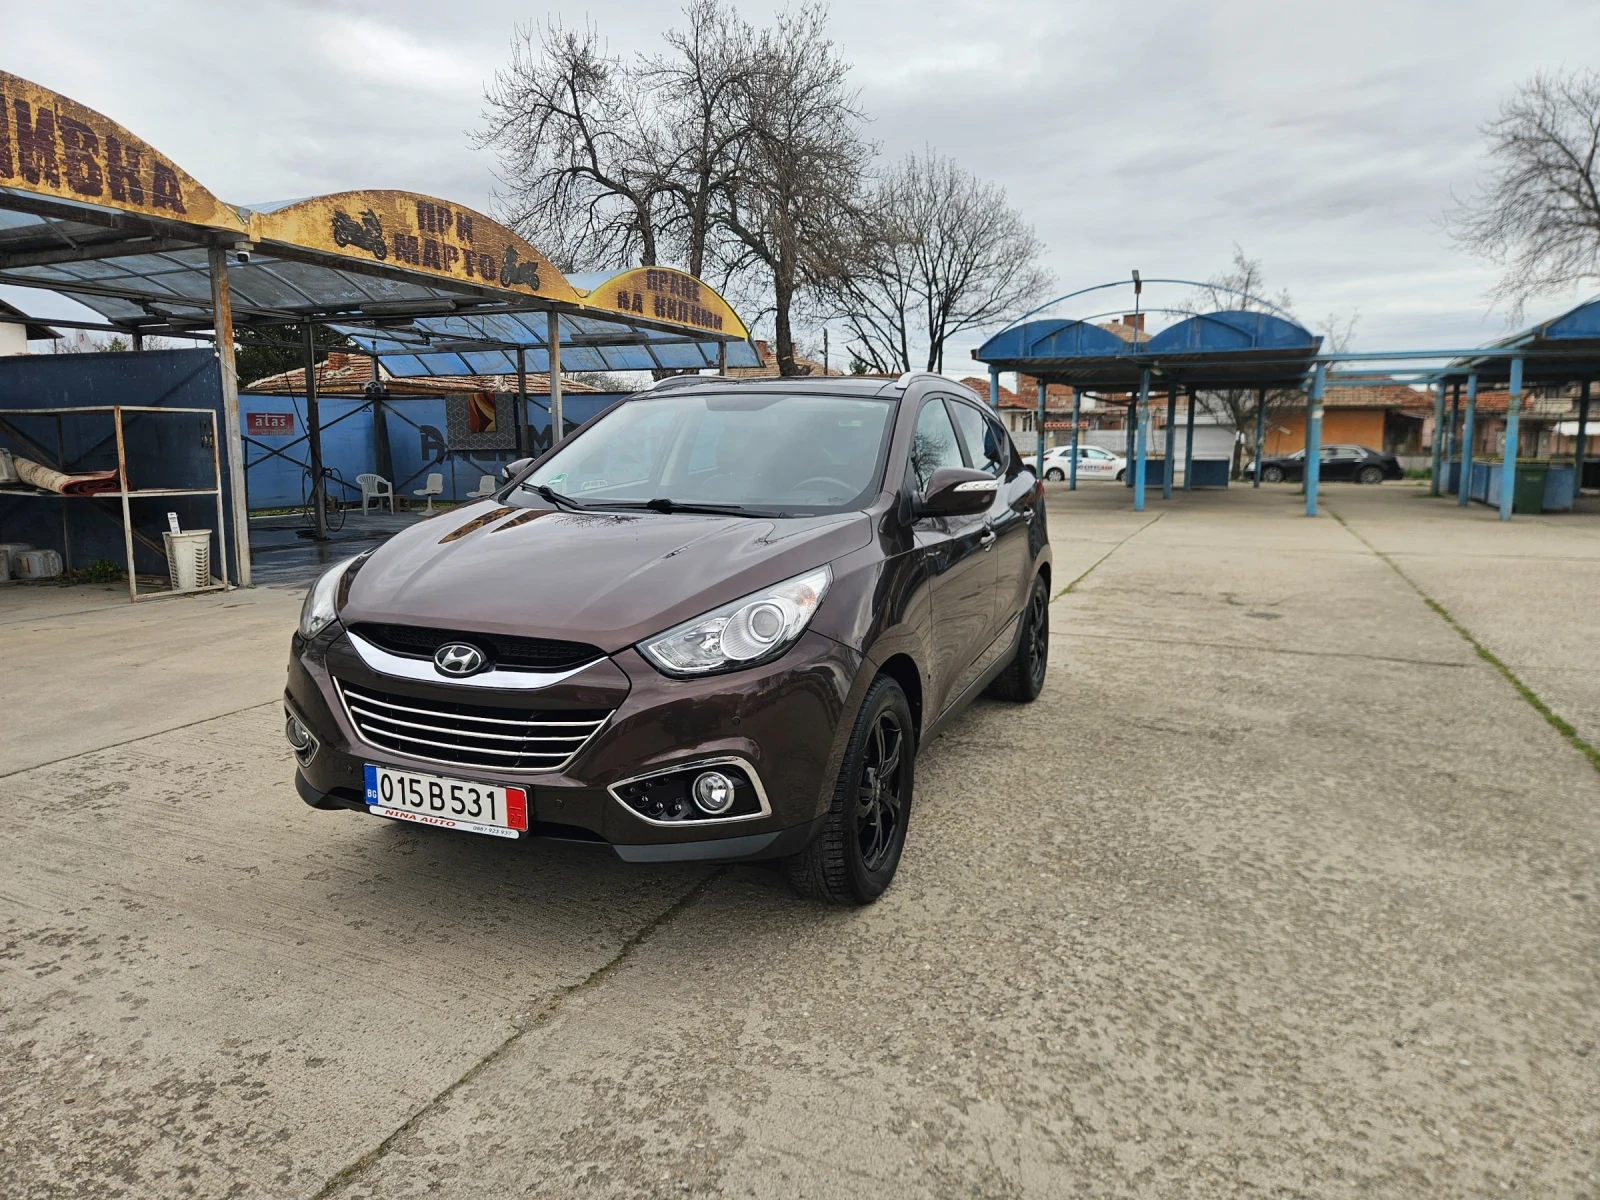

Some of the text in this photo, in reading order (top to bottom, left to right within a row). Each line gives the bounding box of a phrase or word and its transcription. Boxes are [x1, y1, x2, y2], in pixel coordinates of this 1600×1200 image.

[417, 200, 474, 243] ПРИ
[394, 233, 497, 281] МАРТО
[646, 269, 700, 302] ПРАНЕ
[617, 291, 723, 331] НА КИЛИМИ
[255, 413, 286, 427] atas
[367, 788, 377, 799] BG
[380, 773, 496, 821] 015B531
[385, 809, 456, 828] NINA AUTO
[510, 814, 522, 824] 27
